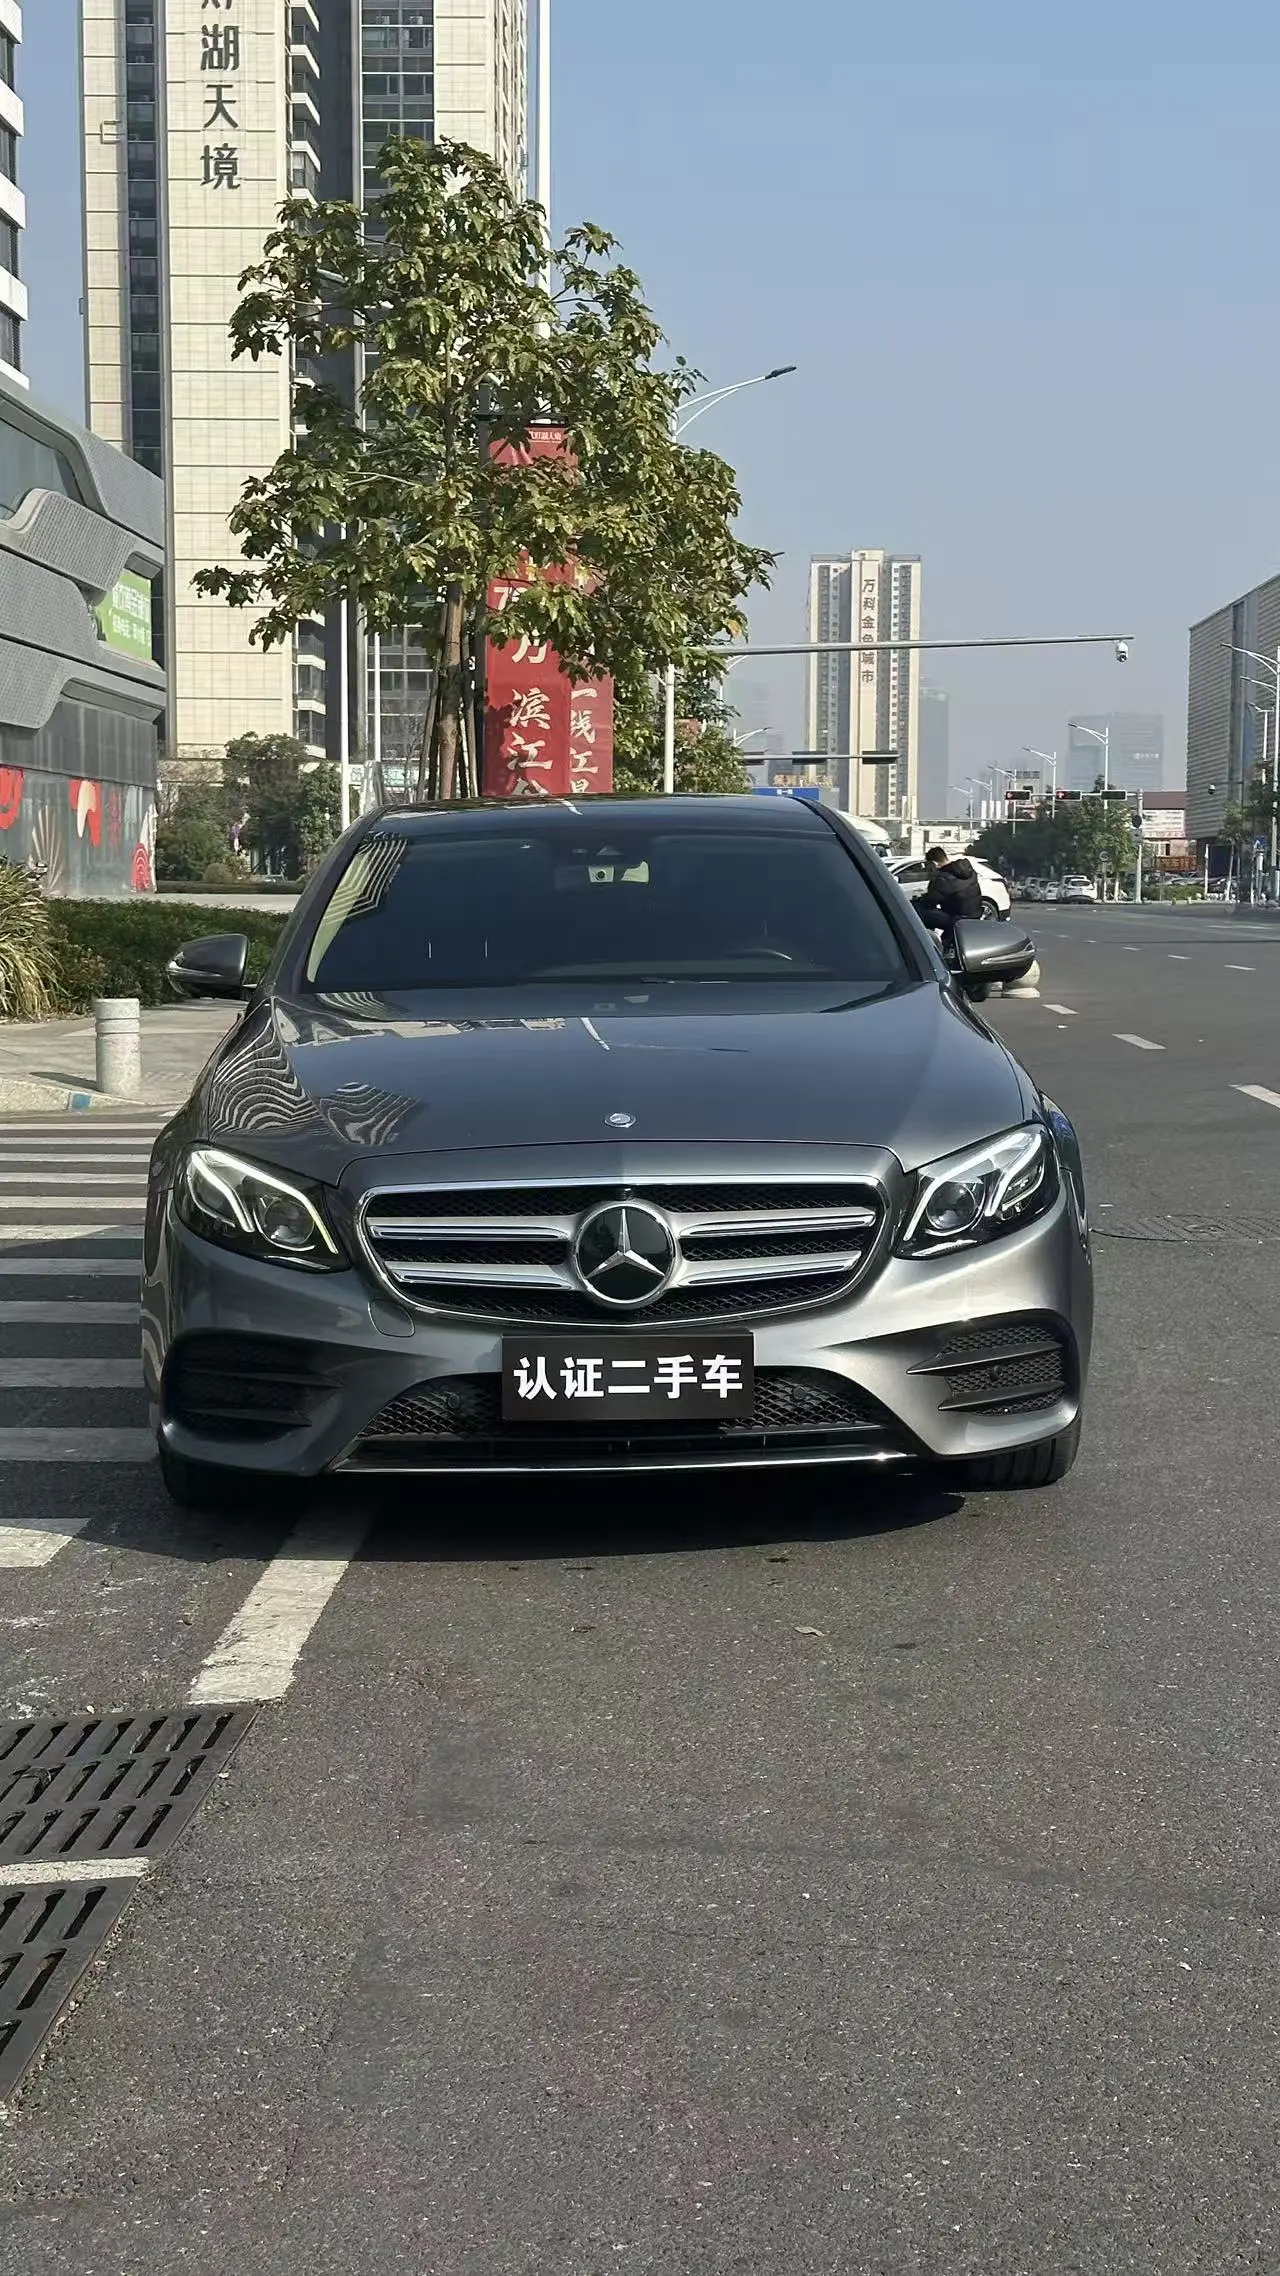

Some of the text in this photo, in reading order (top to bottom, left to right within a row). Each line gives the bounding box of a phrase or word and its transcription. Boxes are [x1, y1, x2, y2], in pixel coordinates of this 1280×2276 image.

[200, 0, 240, 190] 湖天境
[512, 1354, 743, 1400] 认证二手车
